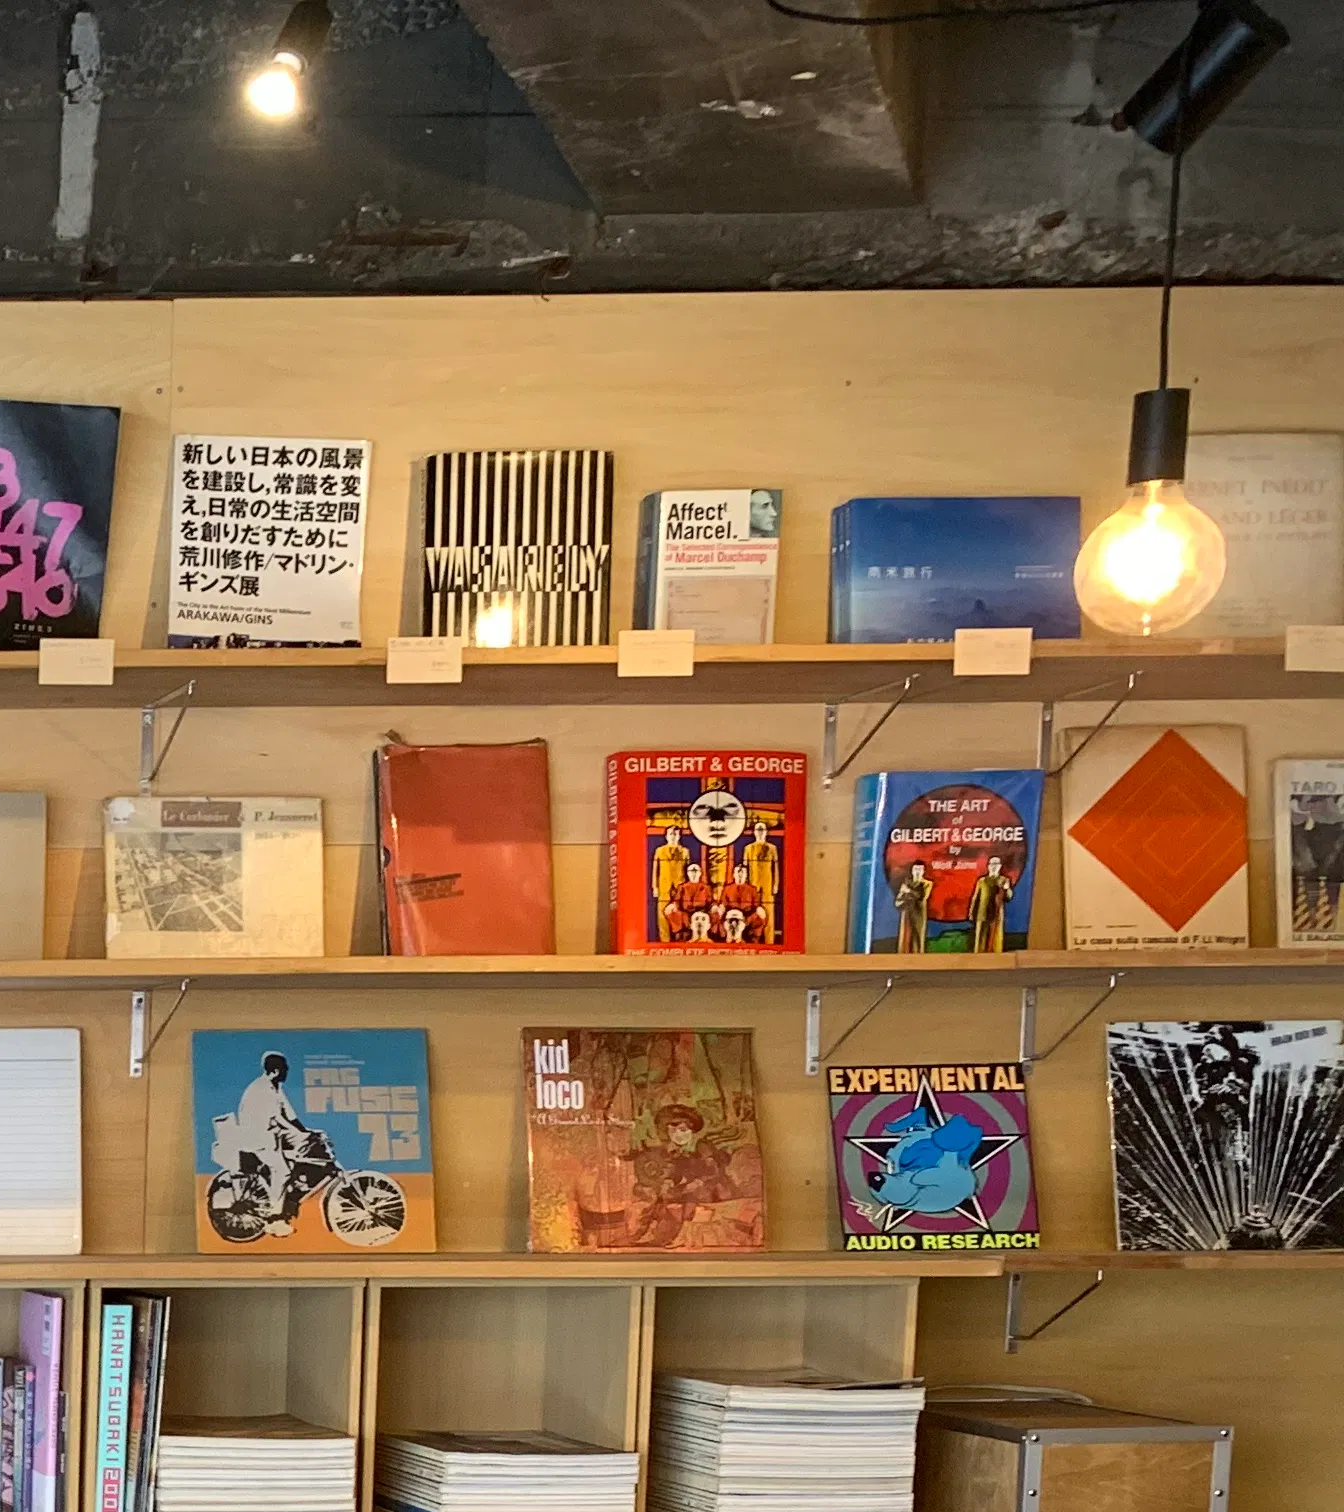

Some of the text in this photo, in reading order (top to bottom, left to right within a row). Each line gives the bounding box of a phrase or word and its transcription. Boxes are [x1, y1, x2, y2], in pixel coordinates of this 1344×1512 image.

[181, 442, 365, 470] 新しい日本の風景
[180, 519, 349, 549] を創りだすために
[425, 544, 610, 593] VASARELY
[675, 553, 714, 564] Marcel
[717, 552, 767, 565] Duchamp
[178, 571, 260, 597] ギンズ展
[177, 609, 274, 625] ARAKAWA/GINS
[624, 756, 805, 774] GILBERT & GEORGE
[927, 799, 991, 813] THE ART
[951, 816, 964, 825] of
[890, 826, 1025, 843] GILBERT & GEORGE
[948, 845, 962, 856] by
[533, 1038, 570, 1074] kid
[535, 1074, 585, 1110] loco
[829, 1065, 1025, 1093] EXPERIMENTAL
[357, 1112, 422, 1162] 73
[846, 1232, 1041, 1251] AUDIO RESEARCH
[105, 1314, 127, 1463] HANATSUBAKI
